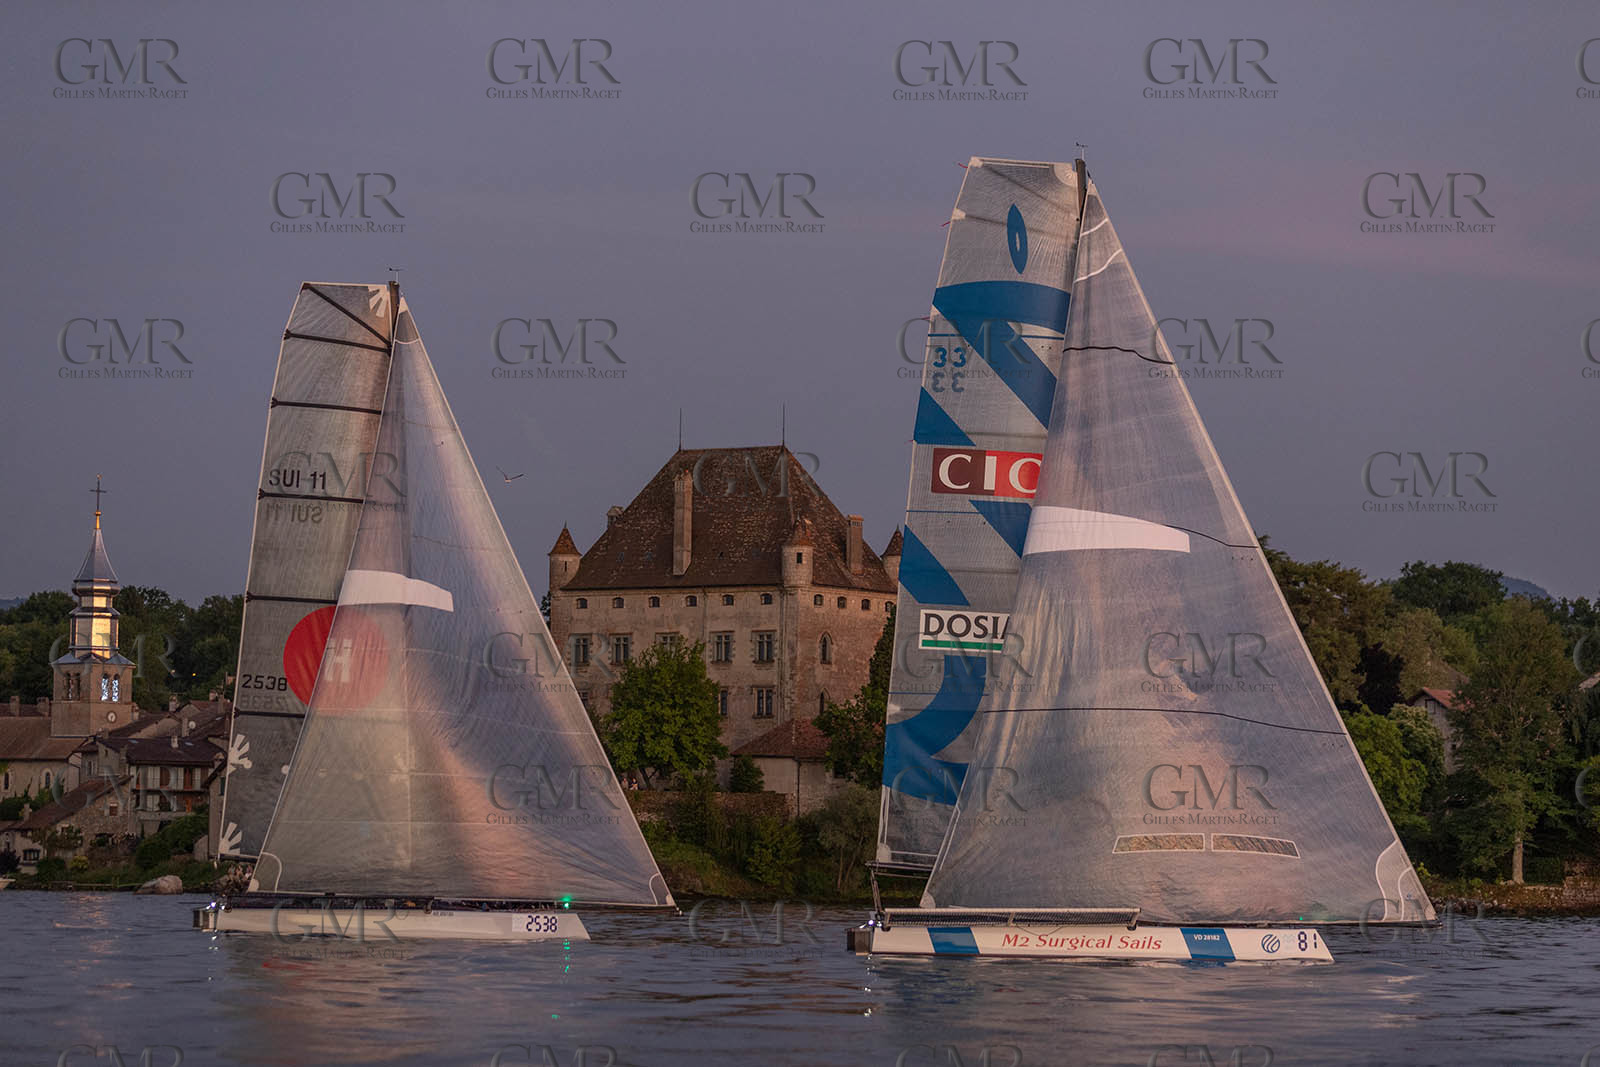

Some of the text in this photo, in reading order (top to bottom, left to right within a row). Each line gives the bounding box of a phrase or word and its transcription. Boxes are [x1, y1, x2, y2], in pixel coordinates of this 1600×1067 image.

[932, 346, 966, 368] 33
[269, 469, 327, 490] SUI 11
[242, 674, 288, 692] 2538
[526, 914, 558, 933] 2538
[1001, 933, 1162, 951] M2 Surgical Sails
